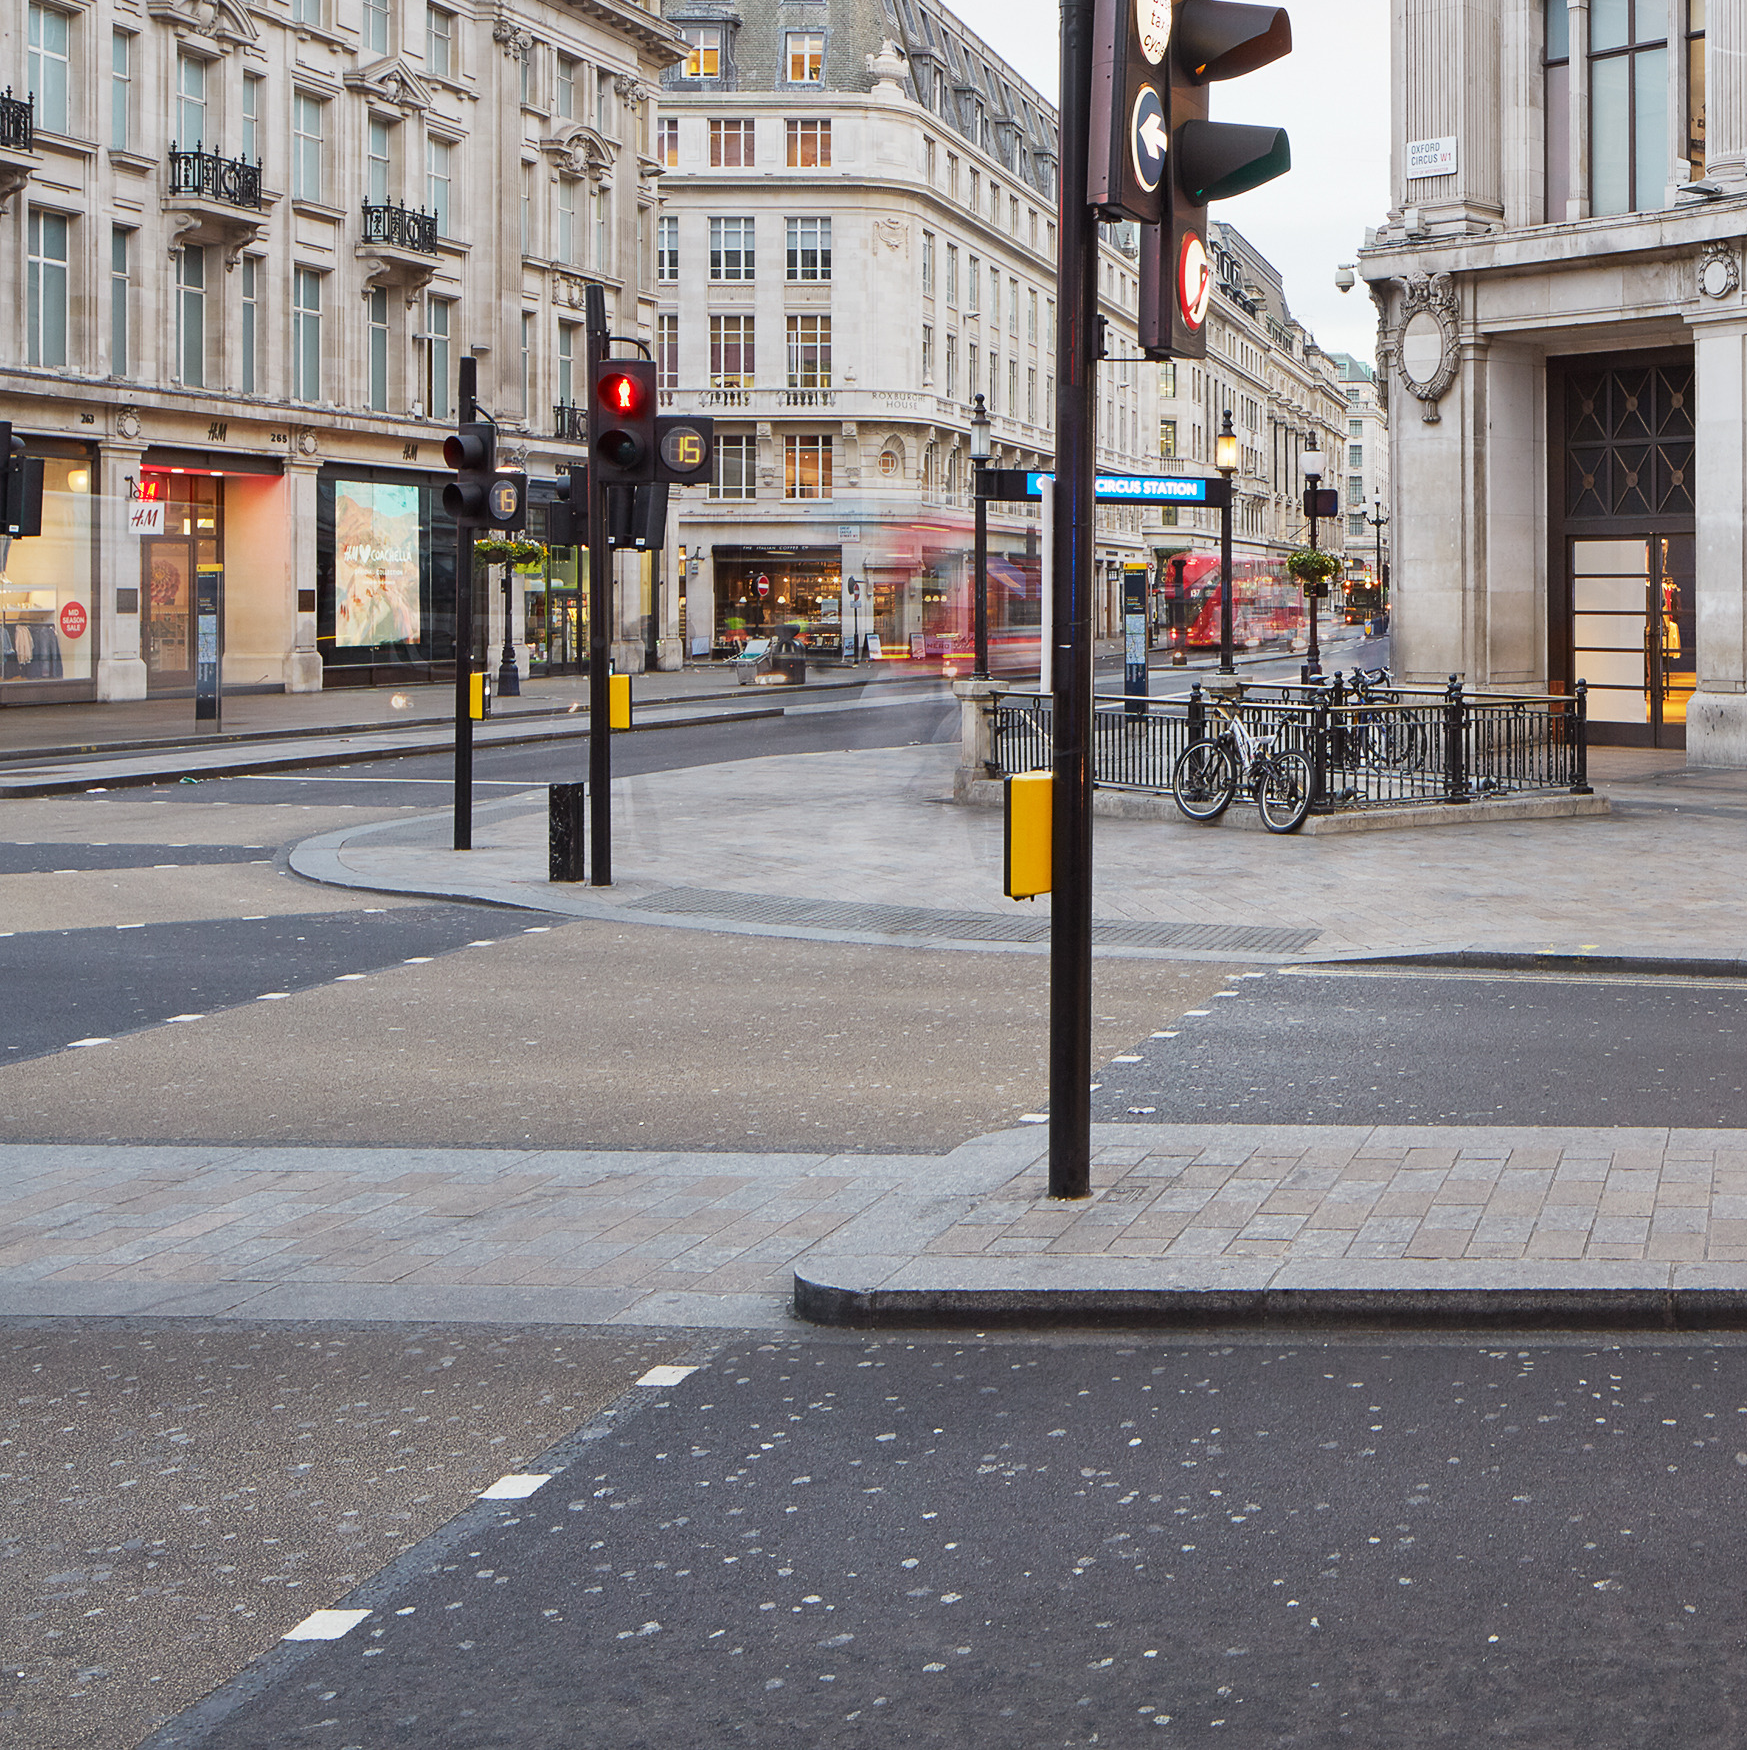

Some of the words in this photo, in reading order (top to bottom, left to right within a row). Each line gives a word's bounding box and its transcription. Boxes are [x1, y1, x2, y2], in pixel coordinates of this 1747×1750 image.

[1411, 142, 1440, 155] OXFORD
[1411, 153, 1438, 166] CIRCUS
[1440, 152, 1451, 162] W1
[872, 391, 926, 402] ROXBURGHE
[886, 400, 917, 410] HOUSE
[81, 413, 95, 425] 263
[207, 422, 228, 442] H&M
[270, 433, 288, 443] 265
[402, 443, 418, 461] H&M
[678, 436, 701, 464] 15
[1095, 479, 1141, 494] CIRCUS
[1143, 481, 1197, 496] STATION
[501, 488, 516, 513] 15
[131, 509, 159, 528] H&M
[370, 549, 412, 563] COACHELLA
[62, 617, 85, 625] SEASON
